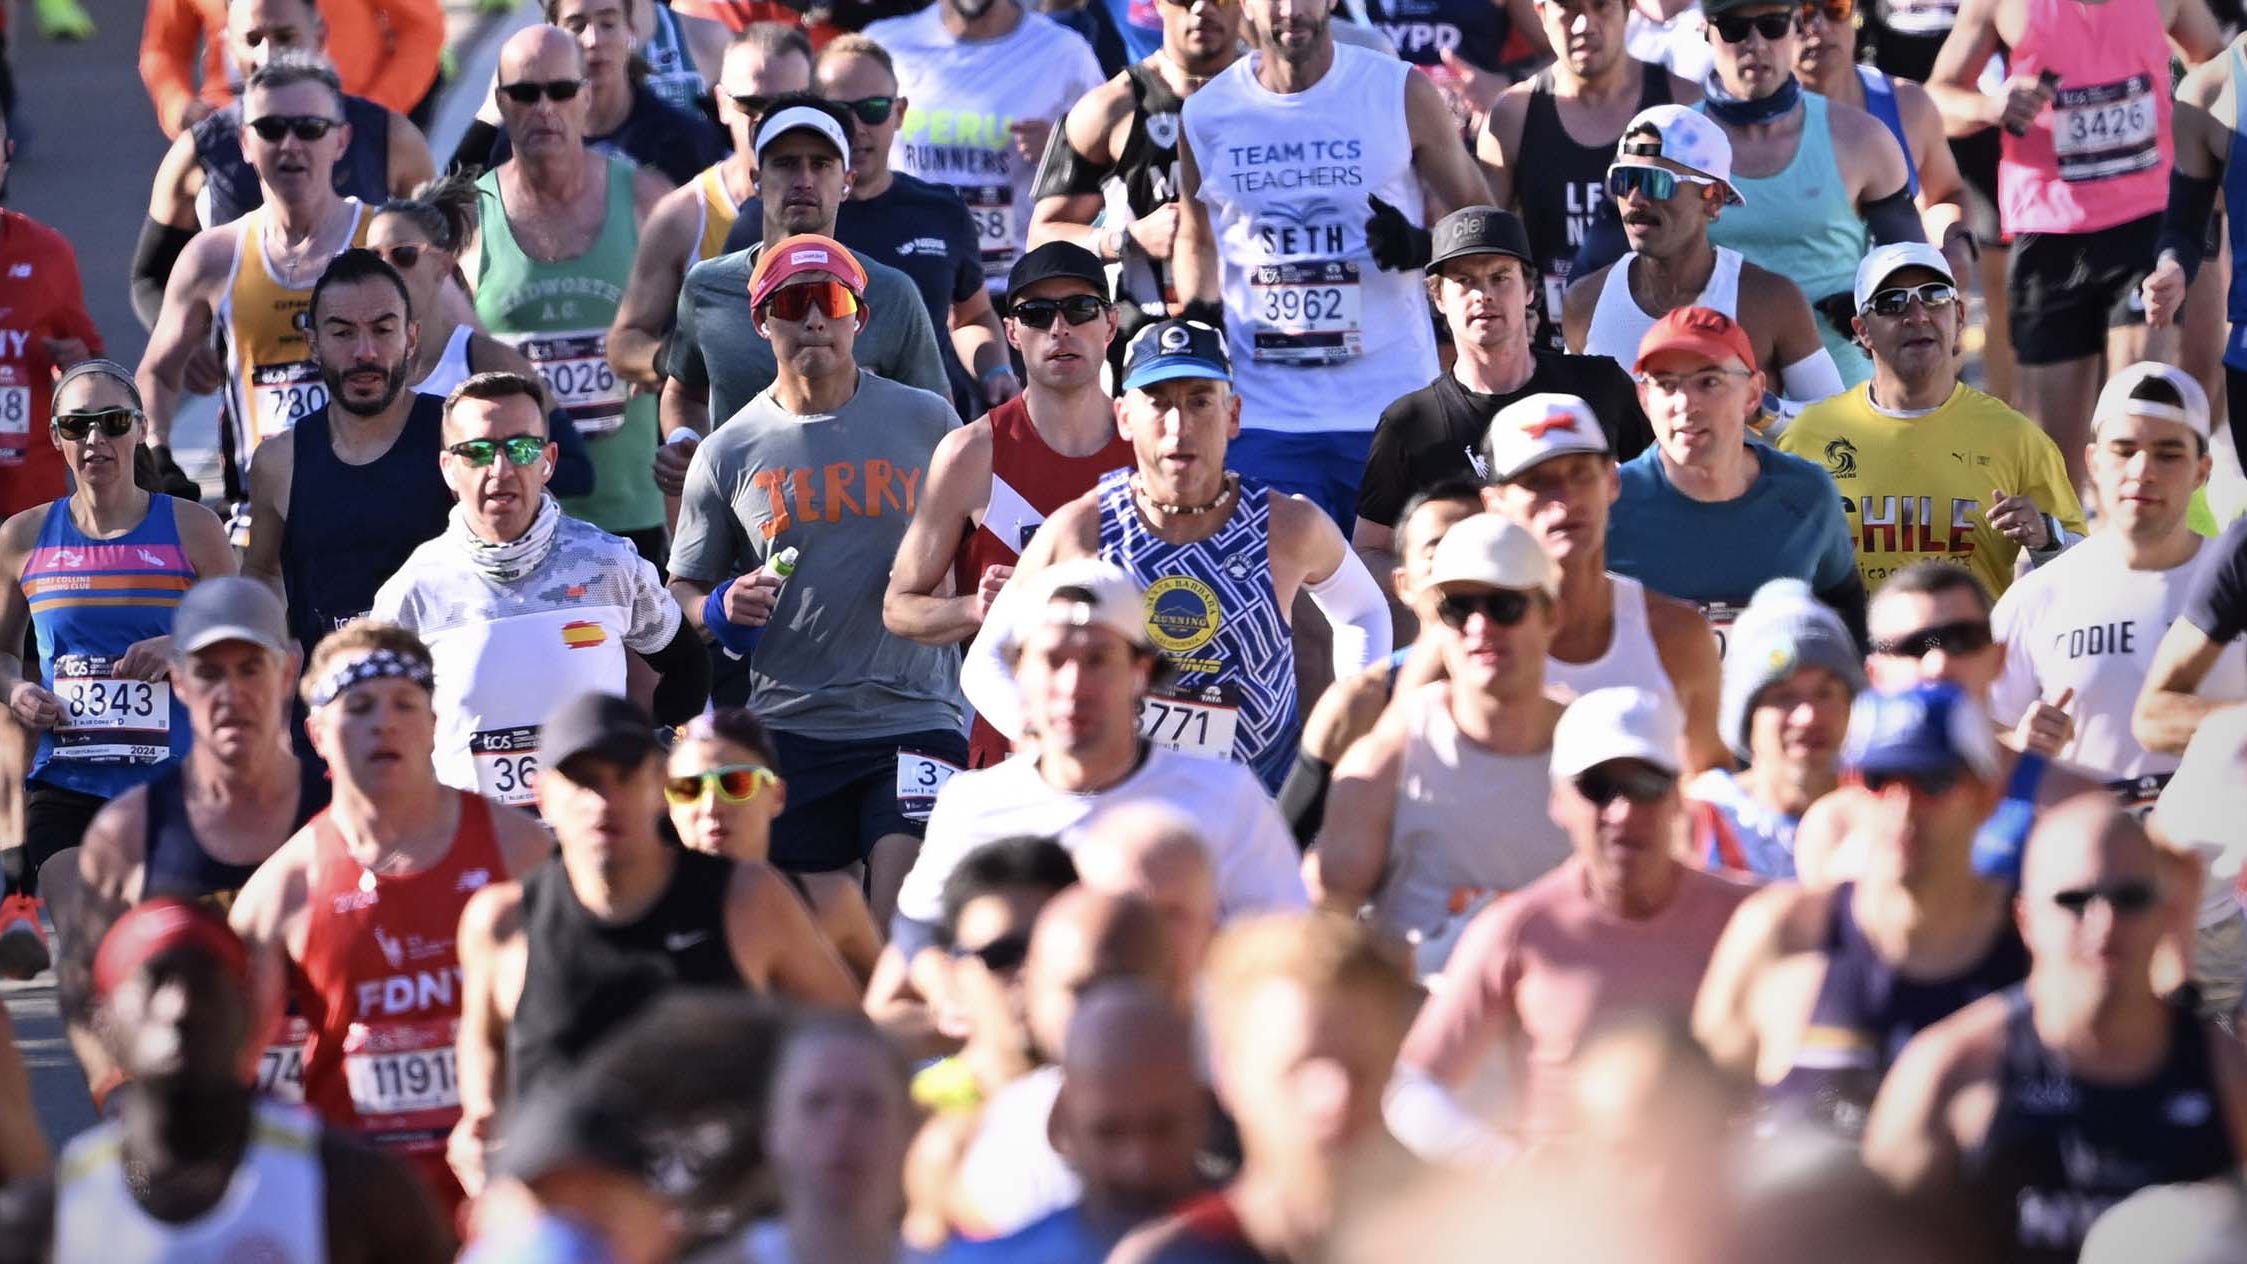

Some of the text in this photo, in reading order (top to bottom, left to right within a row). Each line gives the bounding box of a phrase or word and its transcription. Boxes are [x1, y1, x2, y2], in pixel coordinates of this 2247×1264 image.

[1374, 22, 1461, 54] YPD
[903, 108, 1013, 150] PERU
[2070, 102, 2145, 142] 3426
[1229, 140, 1361, 166] TEAM TCS
[1229, 165, 1363, 192] TEACHERS
[1261, 225, 1343, 255] SETH
[1265, 288, 1343, 321] 3962
[753, 458, 921, 541] JERRY
[1151, 614, 1208, 628] RUNNING
[70, 682, 153, 718] 8343
[1201, 694, 1222, 703] TATA
[130, 746, 156, 756] 2024
[483, 733, 512, 750] tcs
[494, 755, 539, 793] 36
[372, 1053, 458, 1096] 1191
